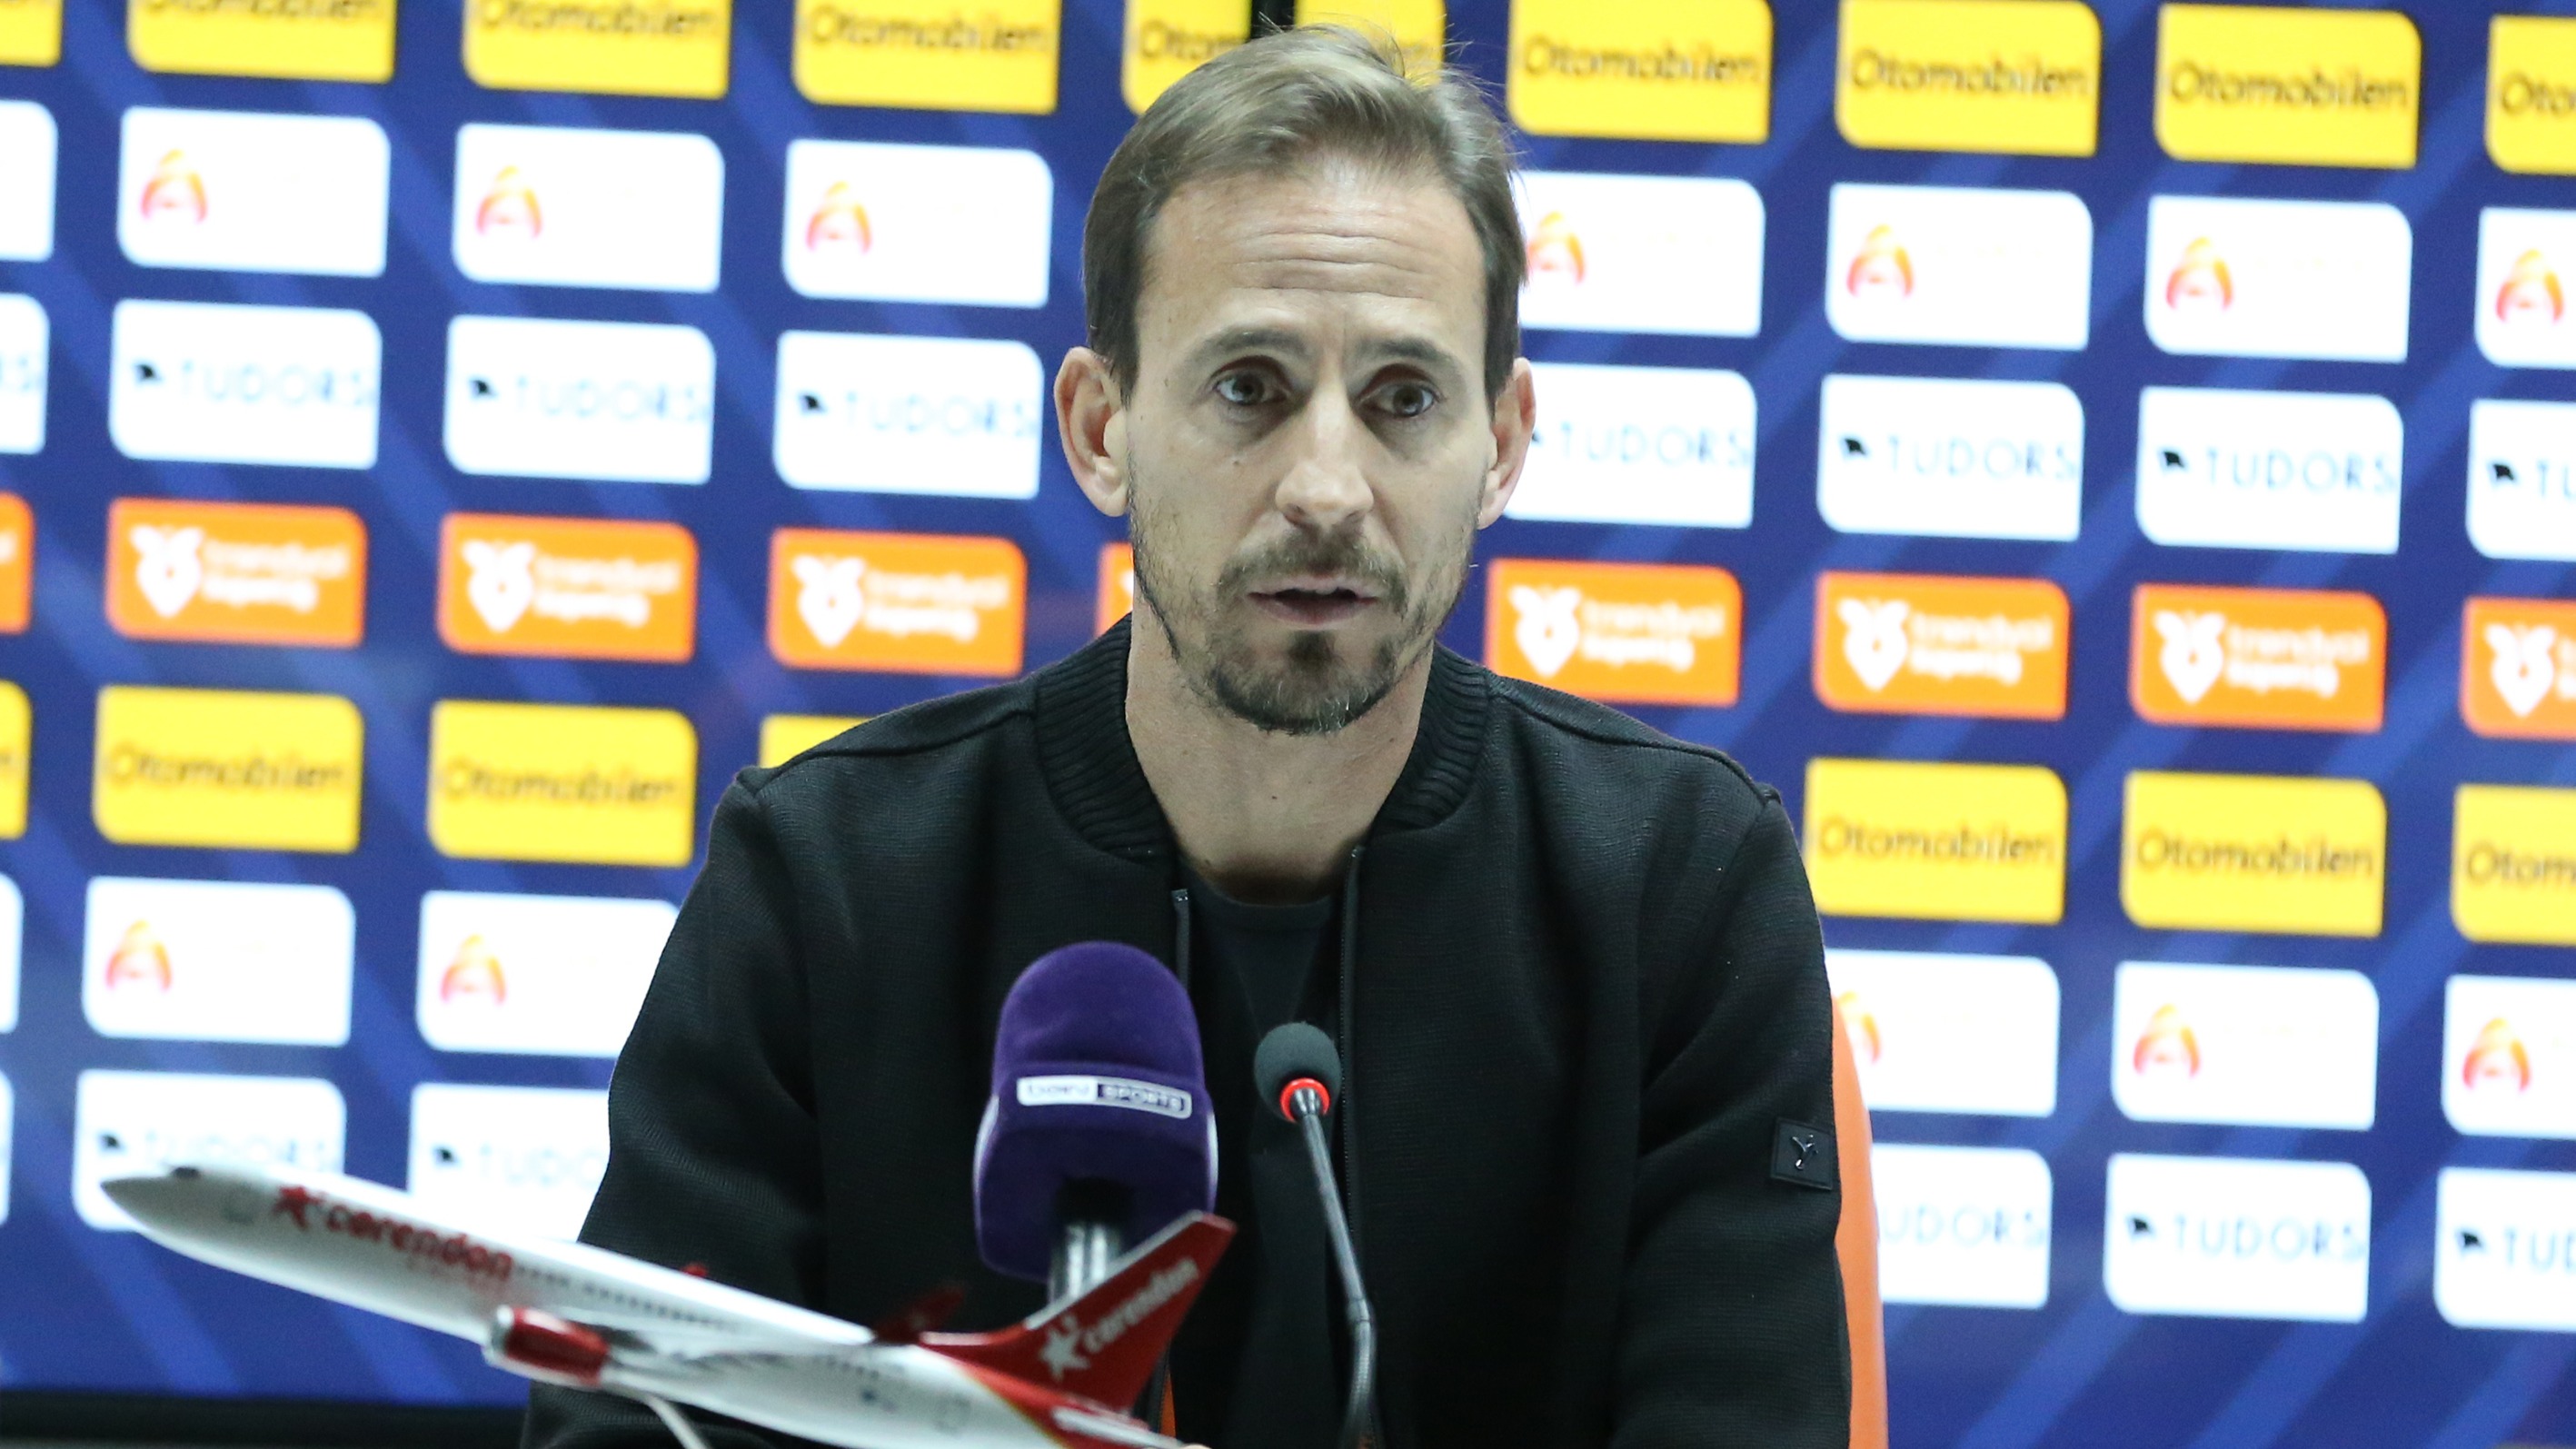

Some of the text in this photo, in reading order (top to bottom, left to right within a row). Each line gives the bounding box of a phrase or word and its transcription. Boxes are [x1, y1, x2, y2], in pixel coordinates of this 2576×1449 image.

[1525, 35, 1761, 84] Otomobilen
[1852, 48, 2091, 97] Otomobilen
[2170, 60, 2410, 110] Otomobilen
[1886, 432, 2078, 481] TUDORS
[2205, 445, 2400, 495] TUDORS
[1818, 818, 2055, 865] Otomobilen
[2137, 829, 2373, 878] Otomobilen
[1880, 1202, 2046, 1249] UDORS
[2173, 1211, 2365, 1262] TUDORS
